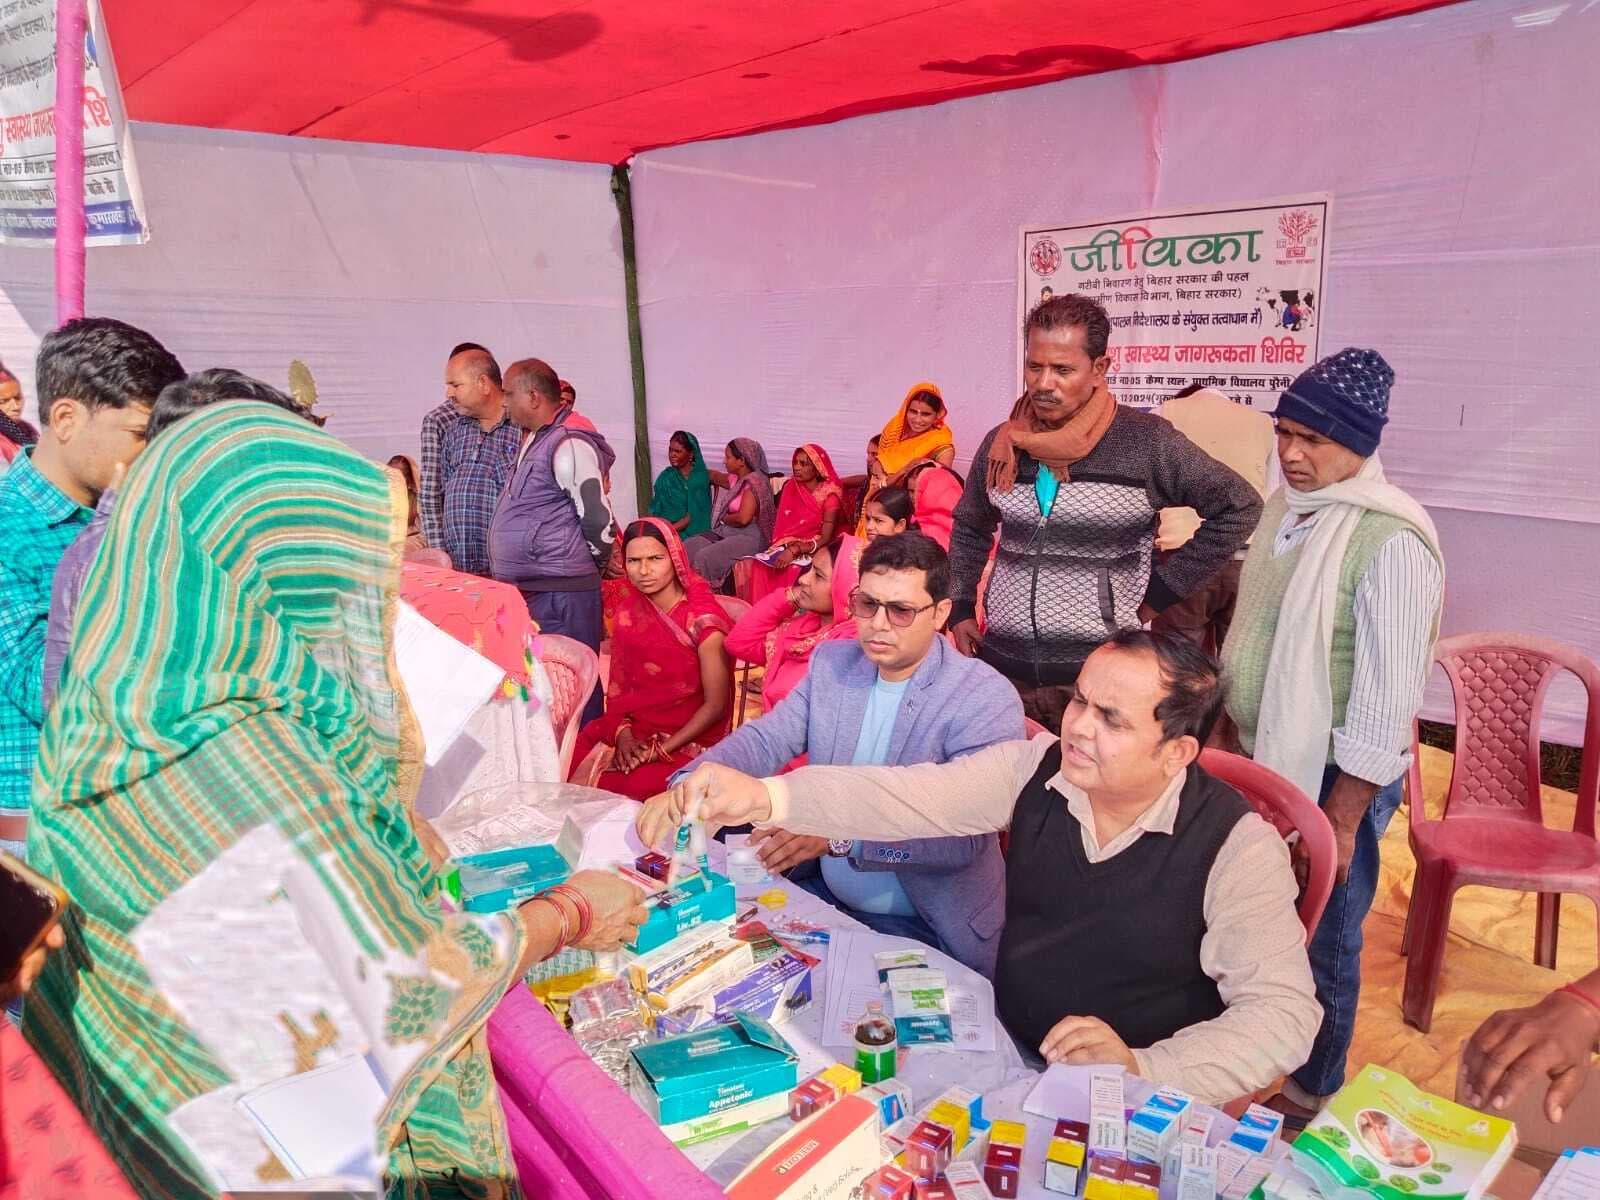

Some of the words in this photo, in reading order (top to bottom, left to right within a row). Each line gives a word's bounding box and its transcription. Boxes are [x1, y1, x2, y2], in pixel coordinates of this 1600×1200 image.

[1063, 226, 1264, 272] जीविका
[1147, 273, 1172, 287] बिहार
[1176, 274, 1207, 285] सरकार
[1211, 270, 1223, 283] की
[1227, 272, 1250, 283] पहल
[1176, 288, 1201, 300] बिहार
[1205, 288, 1242, 299] सरकार)
[1172, 310, 1181, 325] के
[1183, 309, 1209, 332] संयुक्त
[1108, 344, 1121, 372] शु
[1260, 336, 1307, 364] शिविर
[708, 1089, 754, 1111] Appetonic
